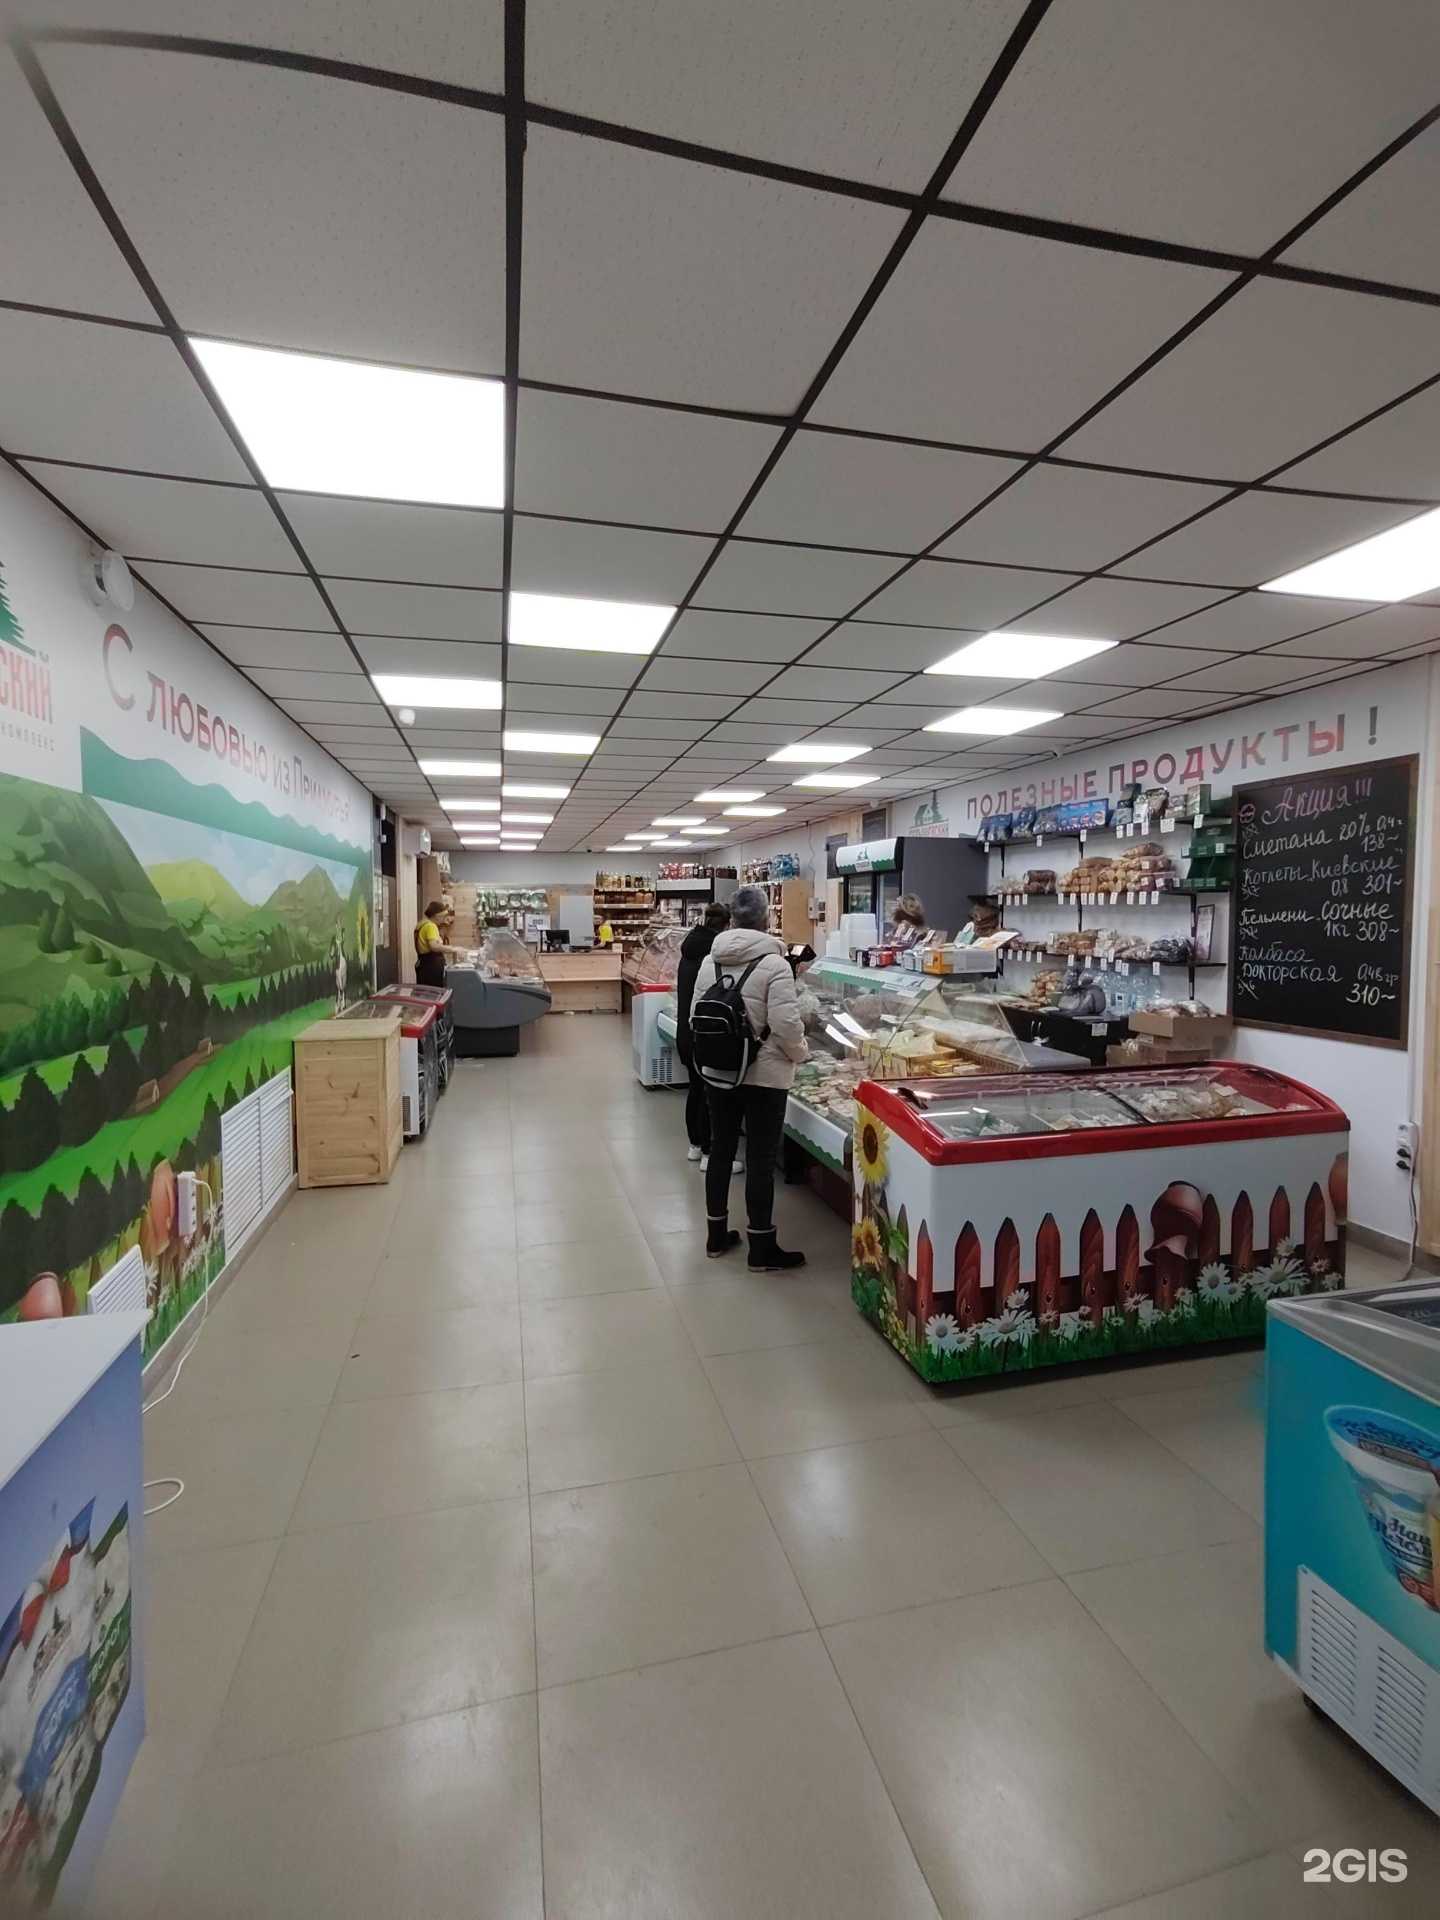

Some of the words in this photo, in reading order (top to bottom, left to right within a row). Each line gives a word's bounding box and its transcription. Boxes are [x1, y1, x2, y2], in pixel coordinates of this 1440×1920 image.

[102, 623, 135, 711] С
[146, 670, 269, 783] ЛЮБОВЬЮ
[967, 769, 1097, 821] ПОЛЕЗНЫЕ
[1108, 713, 1346, 795] ПРОДУКТЫ
[1242, 829, 1333, 860] Сметана
